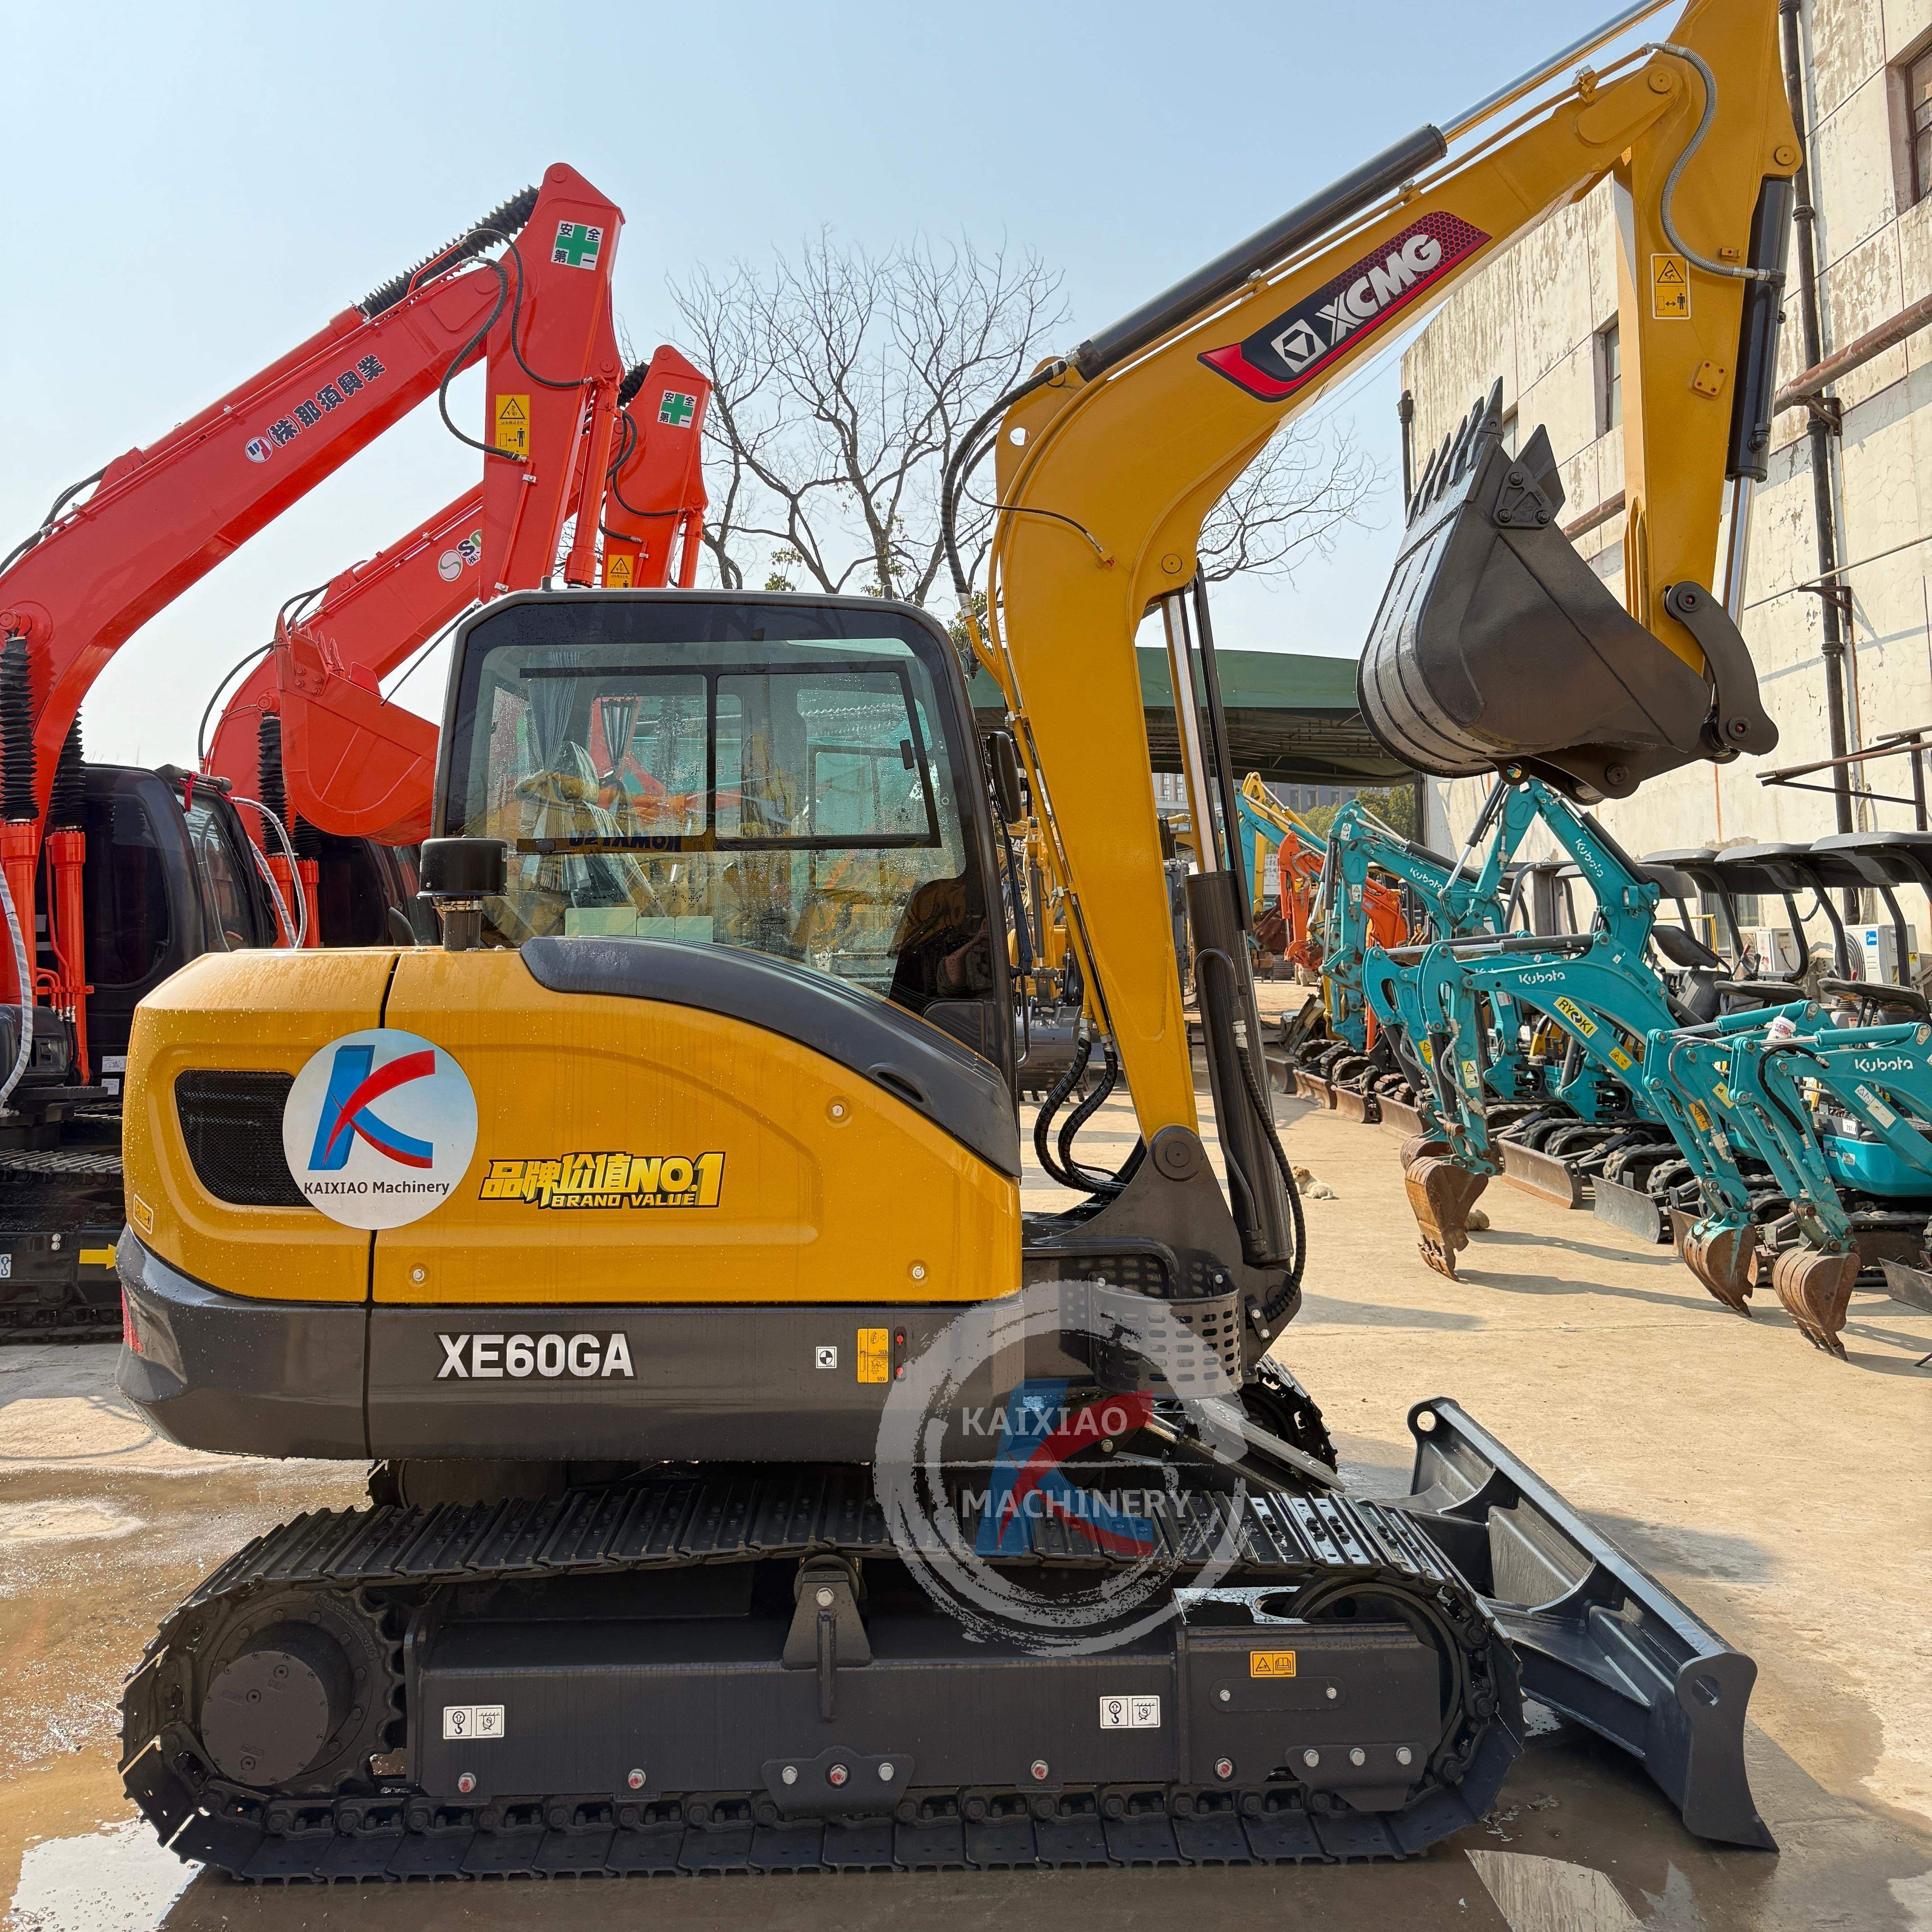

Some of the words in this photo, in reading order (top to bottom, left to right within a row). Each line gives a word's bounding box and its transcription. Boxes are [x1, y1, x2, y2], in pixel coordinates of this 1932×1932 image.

[1315, 234, 1442, 347] XCMG
[1575, 838, 1603, 877] Kubota
[1410, 867, 1443, 890] Kubota
[1518, 970, 1566, 985] Kubota
[1854, 1056, 1913, 1073] Kubota
[304, 1181, 368, 1194] KAIXIAO
[372, 1180, 450, 1195] Machinery
[551, 1194, 621, 1207] BRAND
[631, 1193, 695, 1206] VALUE
[437, 1333, 634, 1378] XE60GA
